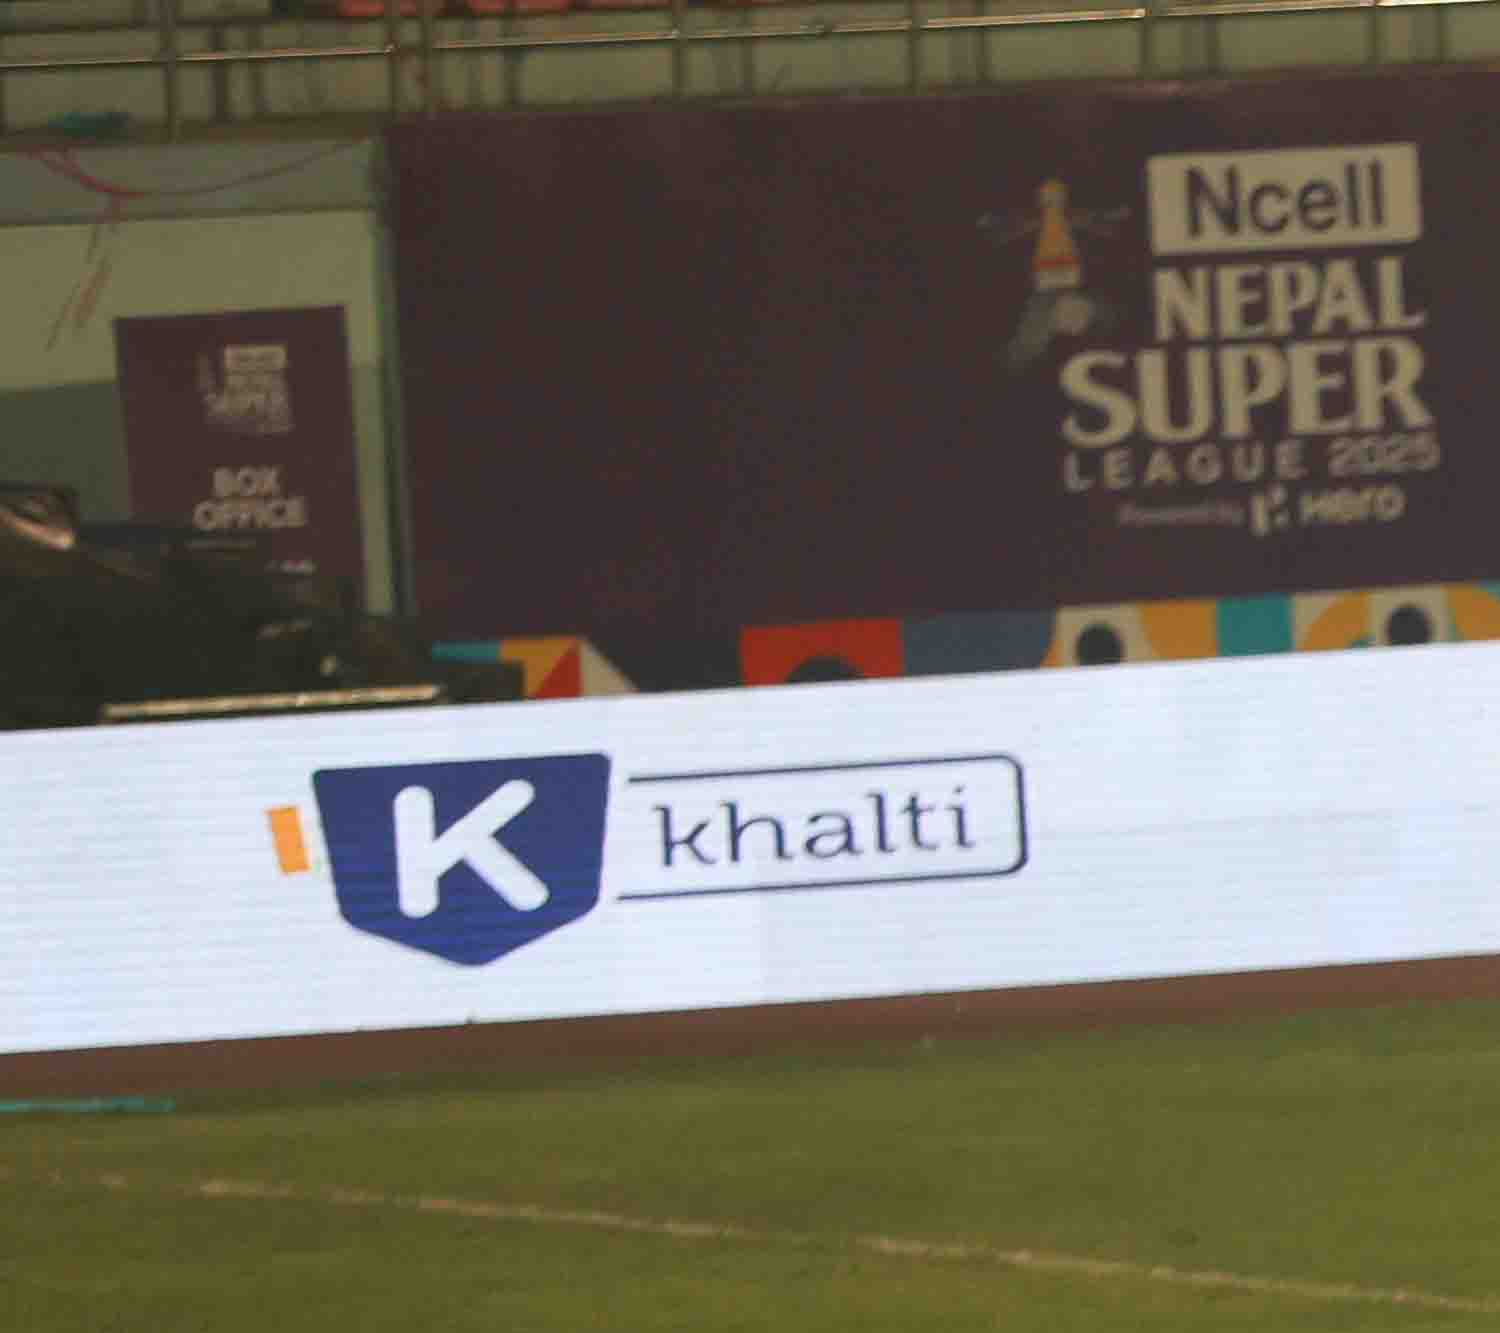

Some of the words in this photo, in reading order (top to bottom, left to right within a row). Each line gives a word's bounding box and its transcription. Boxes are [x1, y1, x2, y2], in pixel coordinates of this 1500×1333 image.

[1184, 158, 1386, 238] Ncell
[1153, 256, 1428, 342] NEPAL
[1058, 334, 1435, 449] SUPER
[213, 466, 282, 497] BOX
[1062, 440, 1309, 492] LEAGUE
[193, 497, 306, 531] OFFICE
[393, 779, 549, 918] K
[655, 784, 977, 869] khalti
